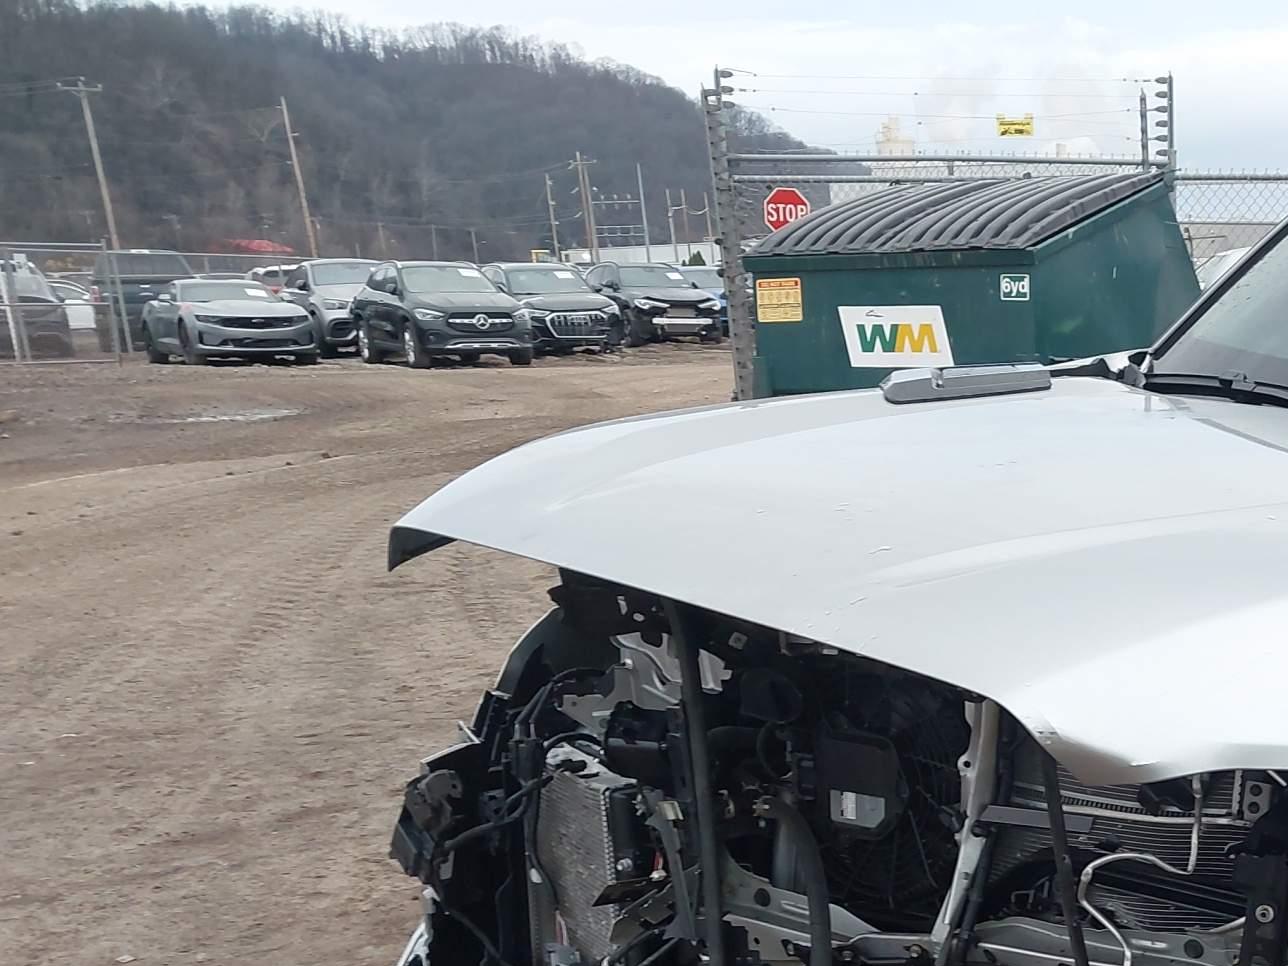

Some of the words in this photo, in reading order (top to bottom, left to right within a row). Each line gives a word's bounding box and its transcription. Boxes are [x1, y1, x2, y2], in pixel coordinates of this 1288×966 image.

[767, 203, 807, 222] STOP
[1003, 277, 1027, 297] 6yd
[855, 323, 938, 353] WM
